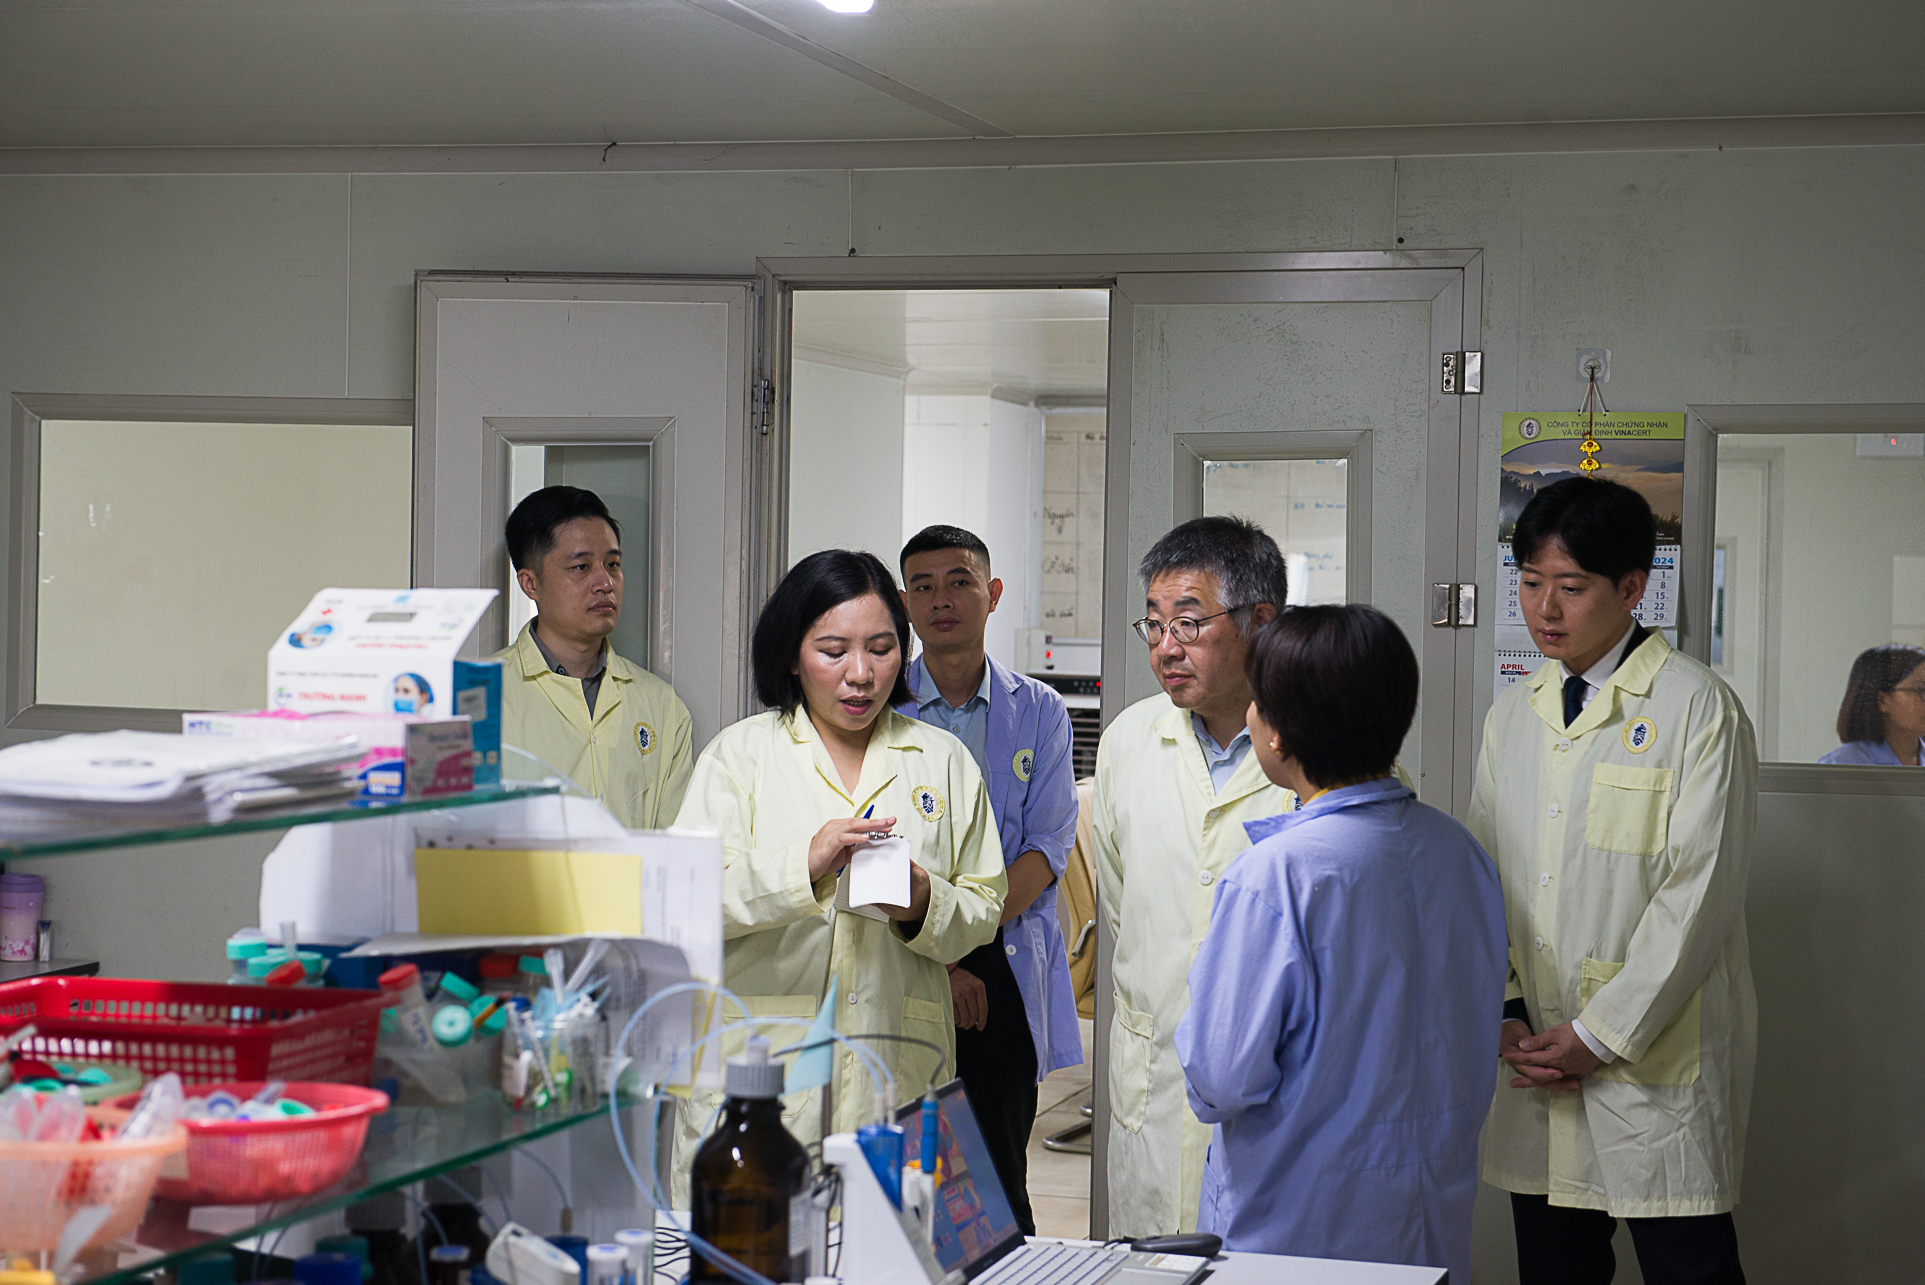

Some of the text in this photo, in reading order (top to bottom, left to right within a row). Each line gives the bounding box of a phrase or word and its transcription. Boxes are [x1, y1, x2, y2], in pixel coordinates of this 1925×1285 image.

[1547, 420, 1569, 428] CÔNG
[1562, 428, 1572, 436] VÀ
[1594, 429, 1613, 437] ĐỊNH
[1653, 556, 1675, 565] 024
[1661, 570, 1666, 579] 1
[1660, 581, 1666, 590] 8
[1655, 592, 1666, 600] 15
[1654, 602, 1665, 610] 22
[1653, 612, 1665, 621] 29
[1500, 663, 1525, 671] APRIL
